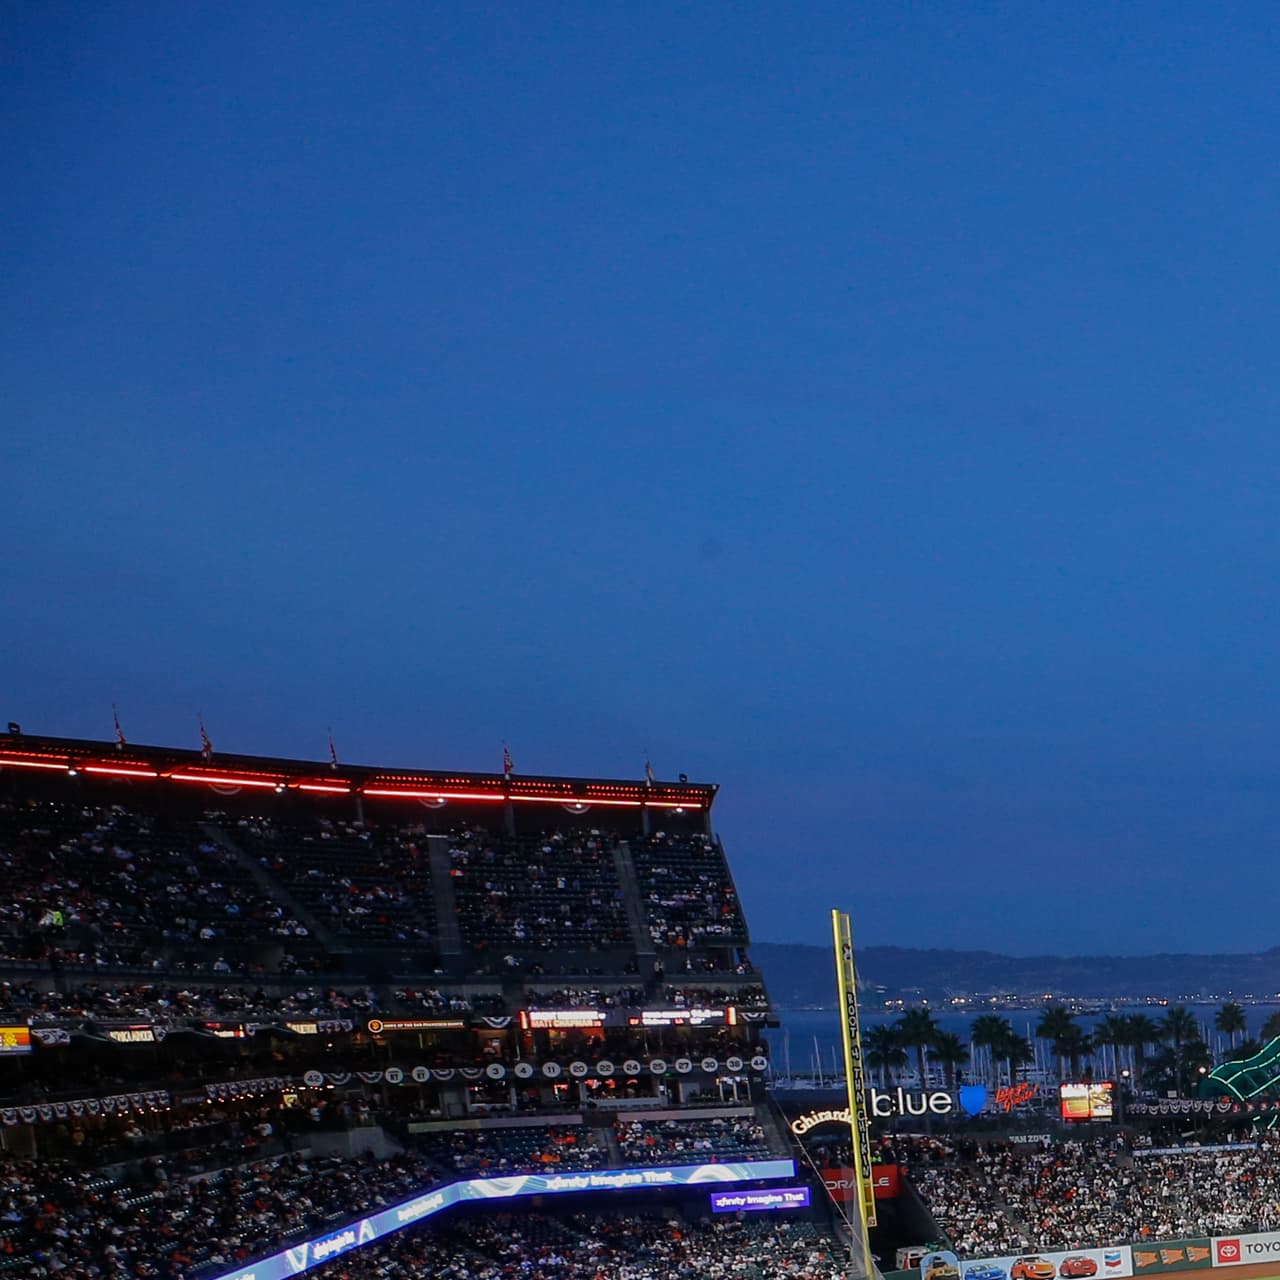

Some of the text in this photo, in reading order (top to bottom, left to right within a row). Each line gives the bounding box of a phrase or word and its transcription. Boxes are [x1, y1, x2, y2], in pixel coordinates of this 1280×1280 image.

[871, 1087, 952, 1117] blue
[591, 1173, 643, 1188] Imagine
[643, 1171, 673, 1183] That
[826, 1176, 890, 1190] ORALE
[716, 1192, 805, 1208] xfinity Imagine That
